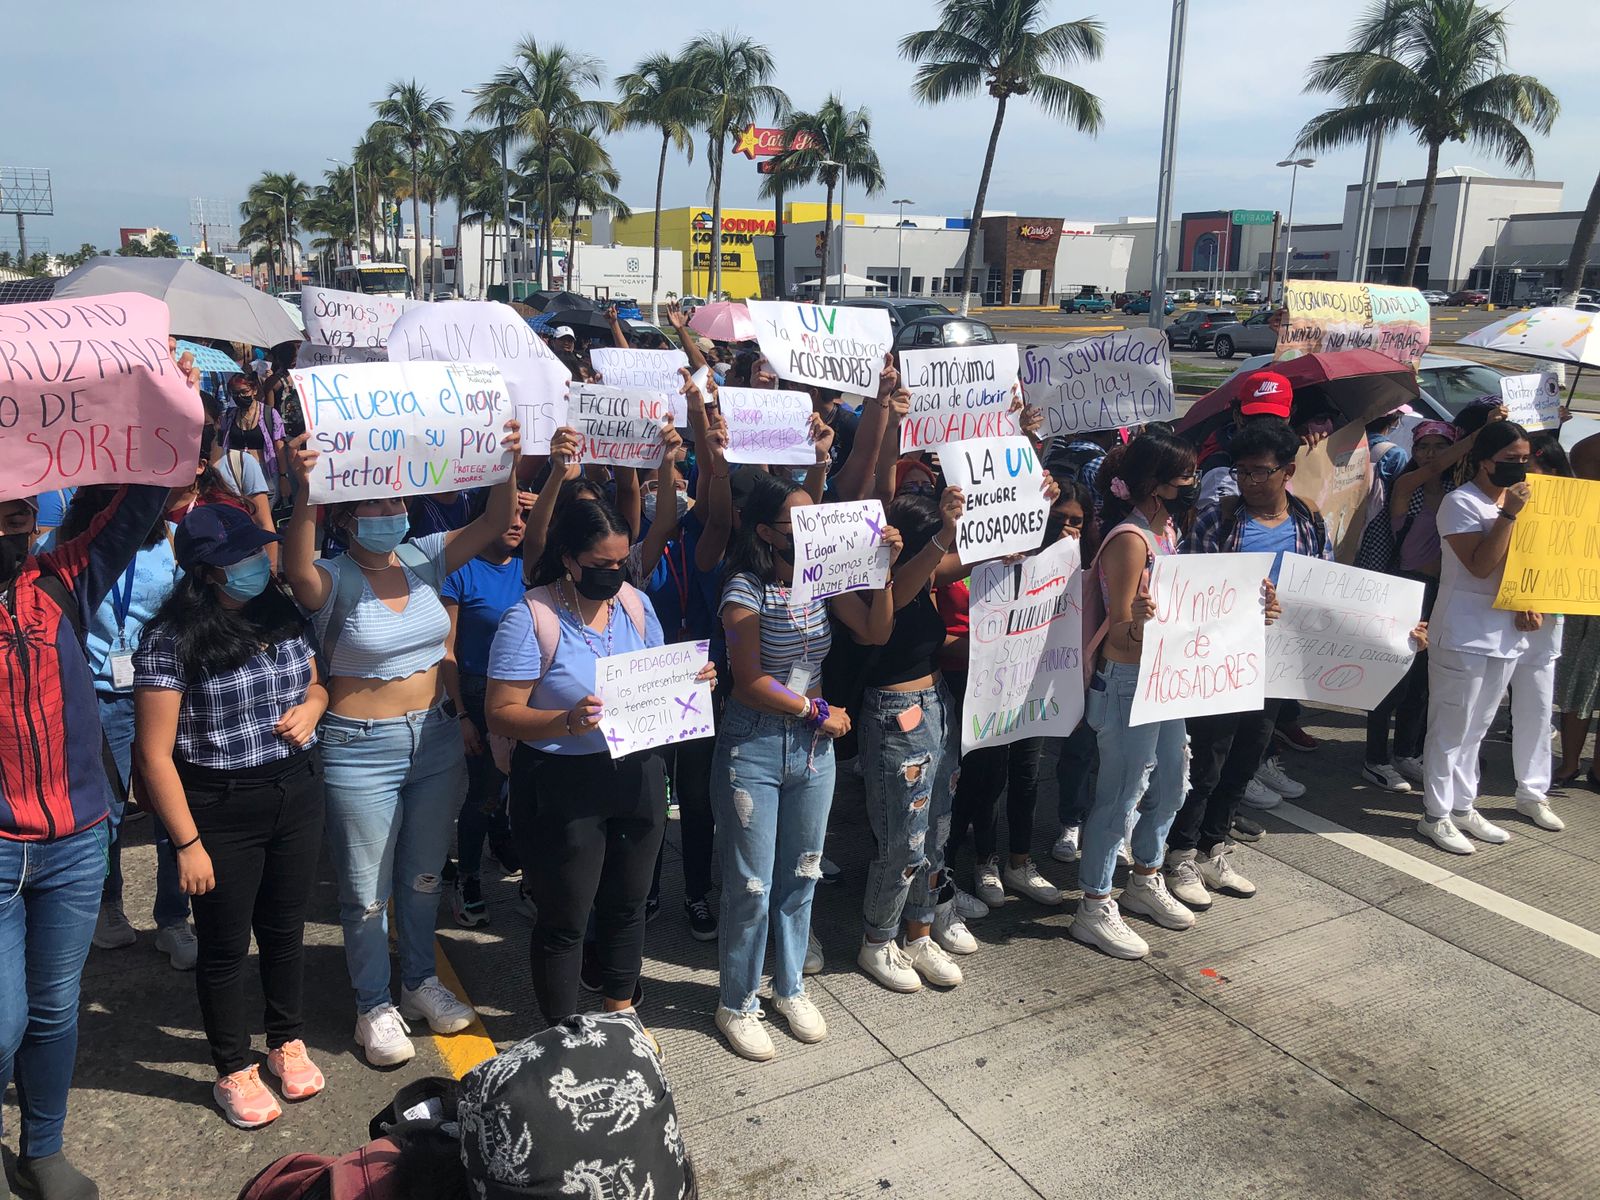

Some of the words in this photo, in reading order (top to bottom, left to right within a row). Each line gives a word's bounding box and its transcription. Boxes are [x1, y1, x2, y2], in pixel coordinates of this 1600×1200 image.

[1235, 213, 1272, 223] ENTRADA
[1288, 289, 1347, 312] DESGRACIADOS
[1348, 293, 1364, 315] LOS
[1371, 294, 1407, 316] DONDE
[1407, 297, 1422, 313] LA
[797, 306, 836, 335] UV
[1281, 323, 1322, 344] JUVENTUD
[367, 327, 387, 348] de
[404, 325, 434, 361] LA
[445, 324, 475, 361] UV
[489, 324, 519, 360] NO
[766, 320, 790, 342] Ya
[802, 333, 821, 354] no
[823, 337, 887, 359] encubras
[1325, 333, 1346, 351] NO
[1346, 331, 1373, 348] HAGA
[1379, 330, 1422, 350] TEMBLAR
[599, 350, 620, 367] NO
[624, 351, 669, 371] DAMOS
[789, 348, 872, 388] ACOSADORES
[906, 359, 929, 388] La
[1023, 350, 1052, 385] Sin
[1058, 335, 1163, 379] seguridad
[440, 369, 464, 415] el
[633, 371, 681, 391] EXIGIMO
[1056, 379, 1086, 402] no
[1094, 372, 1131, 397] hay
[1258, 381, 1279, 392] NIKE
[40, 390, 92, 428] DE
[580, 394, 630, 417] FACICO
[639, 400, 662, 419] NO
[723, 392, 746, 408] NO
[753, 392, 802, 410] DAMOS
[948, 387, 961, 408] de
[1041, 380, 1172, 438] DUCACIÓN
[316, 431, 354, 453] sor
[368, 428, 405, 452] con
[425, 428, 445, 447] su
[579, 419, 634, 438] TOLERA
[641, 422, 658, 438] LA
[903, 411, 1015, 448] ACOSADORES
[0, 424, 178, 492] SORES
[590, 438, 664, 460] VIOLENCIA
[408, 458, 449, 487] UV
[965, 448, 995, 485] LA
[1006, 447, 1033, 477] UV
[966, 486, 1017, 511] ENCUBRE
[1525, 479, 1591, 518] ALZANDO
[797, 510, 816, 532] No
[959, 508, 1044, 549] ACOSADORES
[805, 541, 838, 563] Edgar
[1547, 519, 1577, 556] POR
[803, 563, 823, 584] NO
[828, 557, 862, 576] somos
[867, 552, 878, 564] el
[812, 579, 843, 597] HAZME
[1153, 563, 1189, 625] UV
[1192, 578, 1237, 623] nido
[1287, 562, 1313, 597] LA
[1321, 570, 1391, 605] PALABRA
[1520, 567, 1540, 593] UV
[1542, 567, 1571, 599] MAS
[1280, 603, 1398, 642] JUSTICIA
[995, 631, 1047, 665] SOMOS
[1184, 626, 1211, 659] de
[606, 664, 623, 681] En
[629, 650, 692, 674] PEDAGOGIA
[1296, 663, 1323, 680] LA
[616, 686, 632, 698] los
[604, 706, 619, 718] no
[625, 696, 667, 713] tenemos
[972, 696, 1060, 741] VALIENTES
